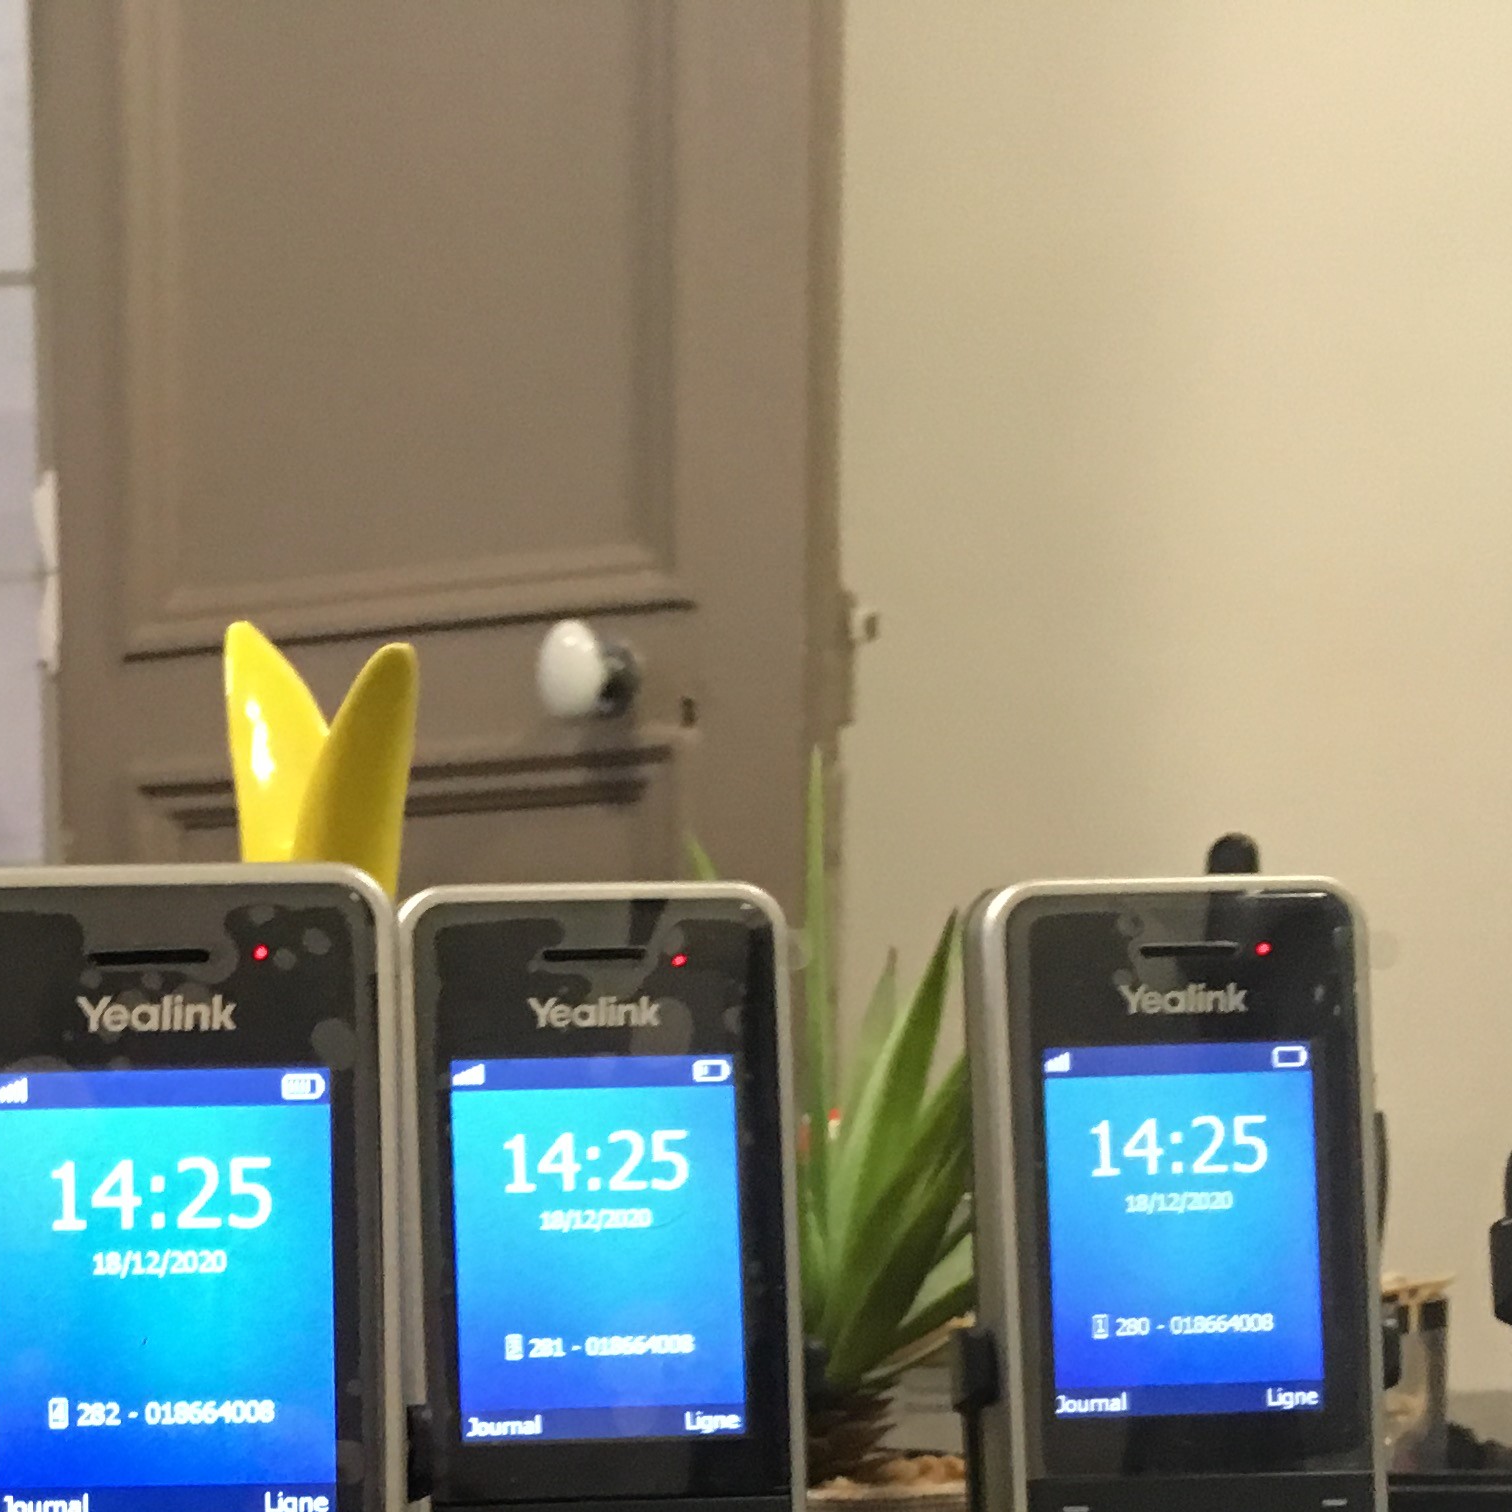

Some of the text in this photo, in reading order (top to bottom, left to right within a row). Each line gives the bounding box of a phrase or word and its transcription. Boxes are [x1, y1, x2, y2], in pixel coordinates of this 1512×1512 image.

[1122, 983, 1248, 1015] Yealink
[76, 995, 236, 1032] Yealink
[529, 997, 660, 1029] Yealink
[1089, 1116, 1269, 1178] 14:25
[504, 1130, 689, 1193] 14:25
[50, 1158, 273, 1232] 14:25
[1126, 1192, 1233, 1213] 18/12/2020
[539, 1210, 652, 1231] 18/12/2020
[93, 1250, 226, 1278] 18/12/2020
[1116, 1317, 1149, 1336] 280
[529, 1337, 565, 1358] 281
[1056, 1393, 1127, 1415] Journal
[1267, 1388, 1319, 1408] Ligne
[76, 1401, 120, 1425] 282
[145, 1400, 274, 1425] 018664008
[685, 1411, 741, 1432] Ligne
[467, 1416, 542, 1438] Journal
